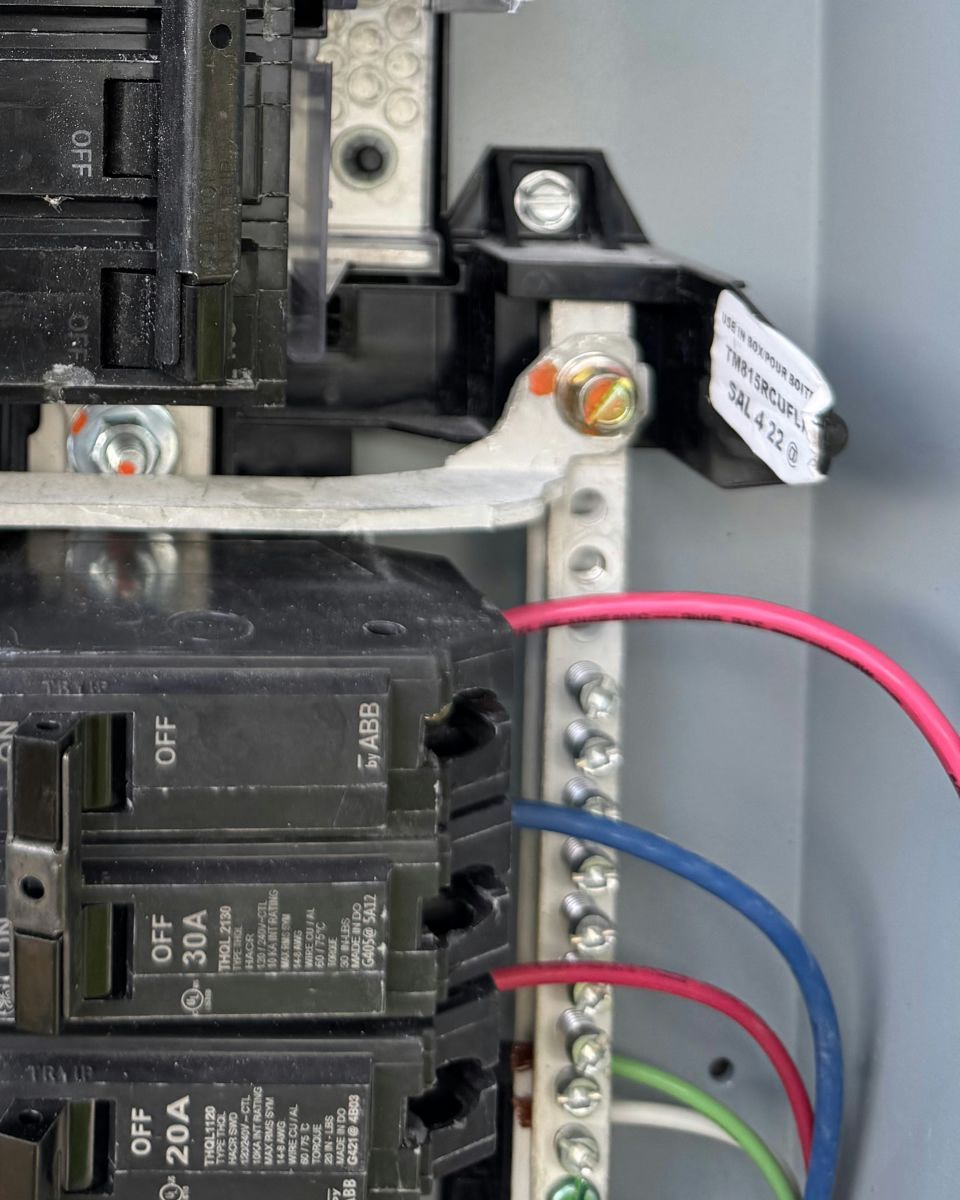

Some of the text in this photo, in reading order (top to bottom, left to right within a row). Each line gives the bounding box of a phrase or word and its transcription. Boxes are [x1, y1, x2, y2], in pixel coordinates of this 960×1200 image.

[71, 130, 92, 177] OFF
[728, 380, 751, 420] SAL
[754, 410, 764, 431] 4
[767, 421, 784, 452] 22
[155, 715, 176, 765] OFF
[358, 702, 383, 769] by ABB
[151, 913, 172, 962] OFF
[182, 909, 207, 965] 30A
[218, 905, 232, 972] THQL 2130
[350, 935, 361, 968] MADE
[130, 1107, 152, 1156] OFF
[165, 1094, 190, 1166] 20A
[348, 1094, 360, 1124] 4B03
[204, 1105, 216, 1167] THQL1120
[336, 1136, 345, 1165] MADE
[342, 1179, 356, 1200] BB
